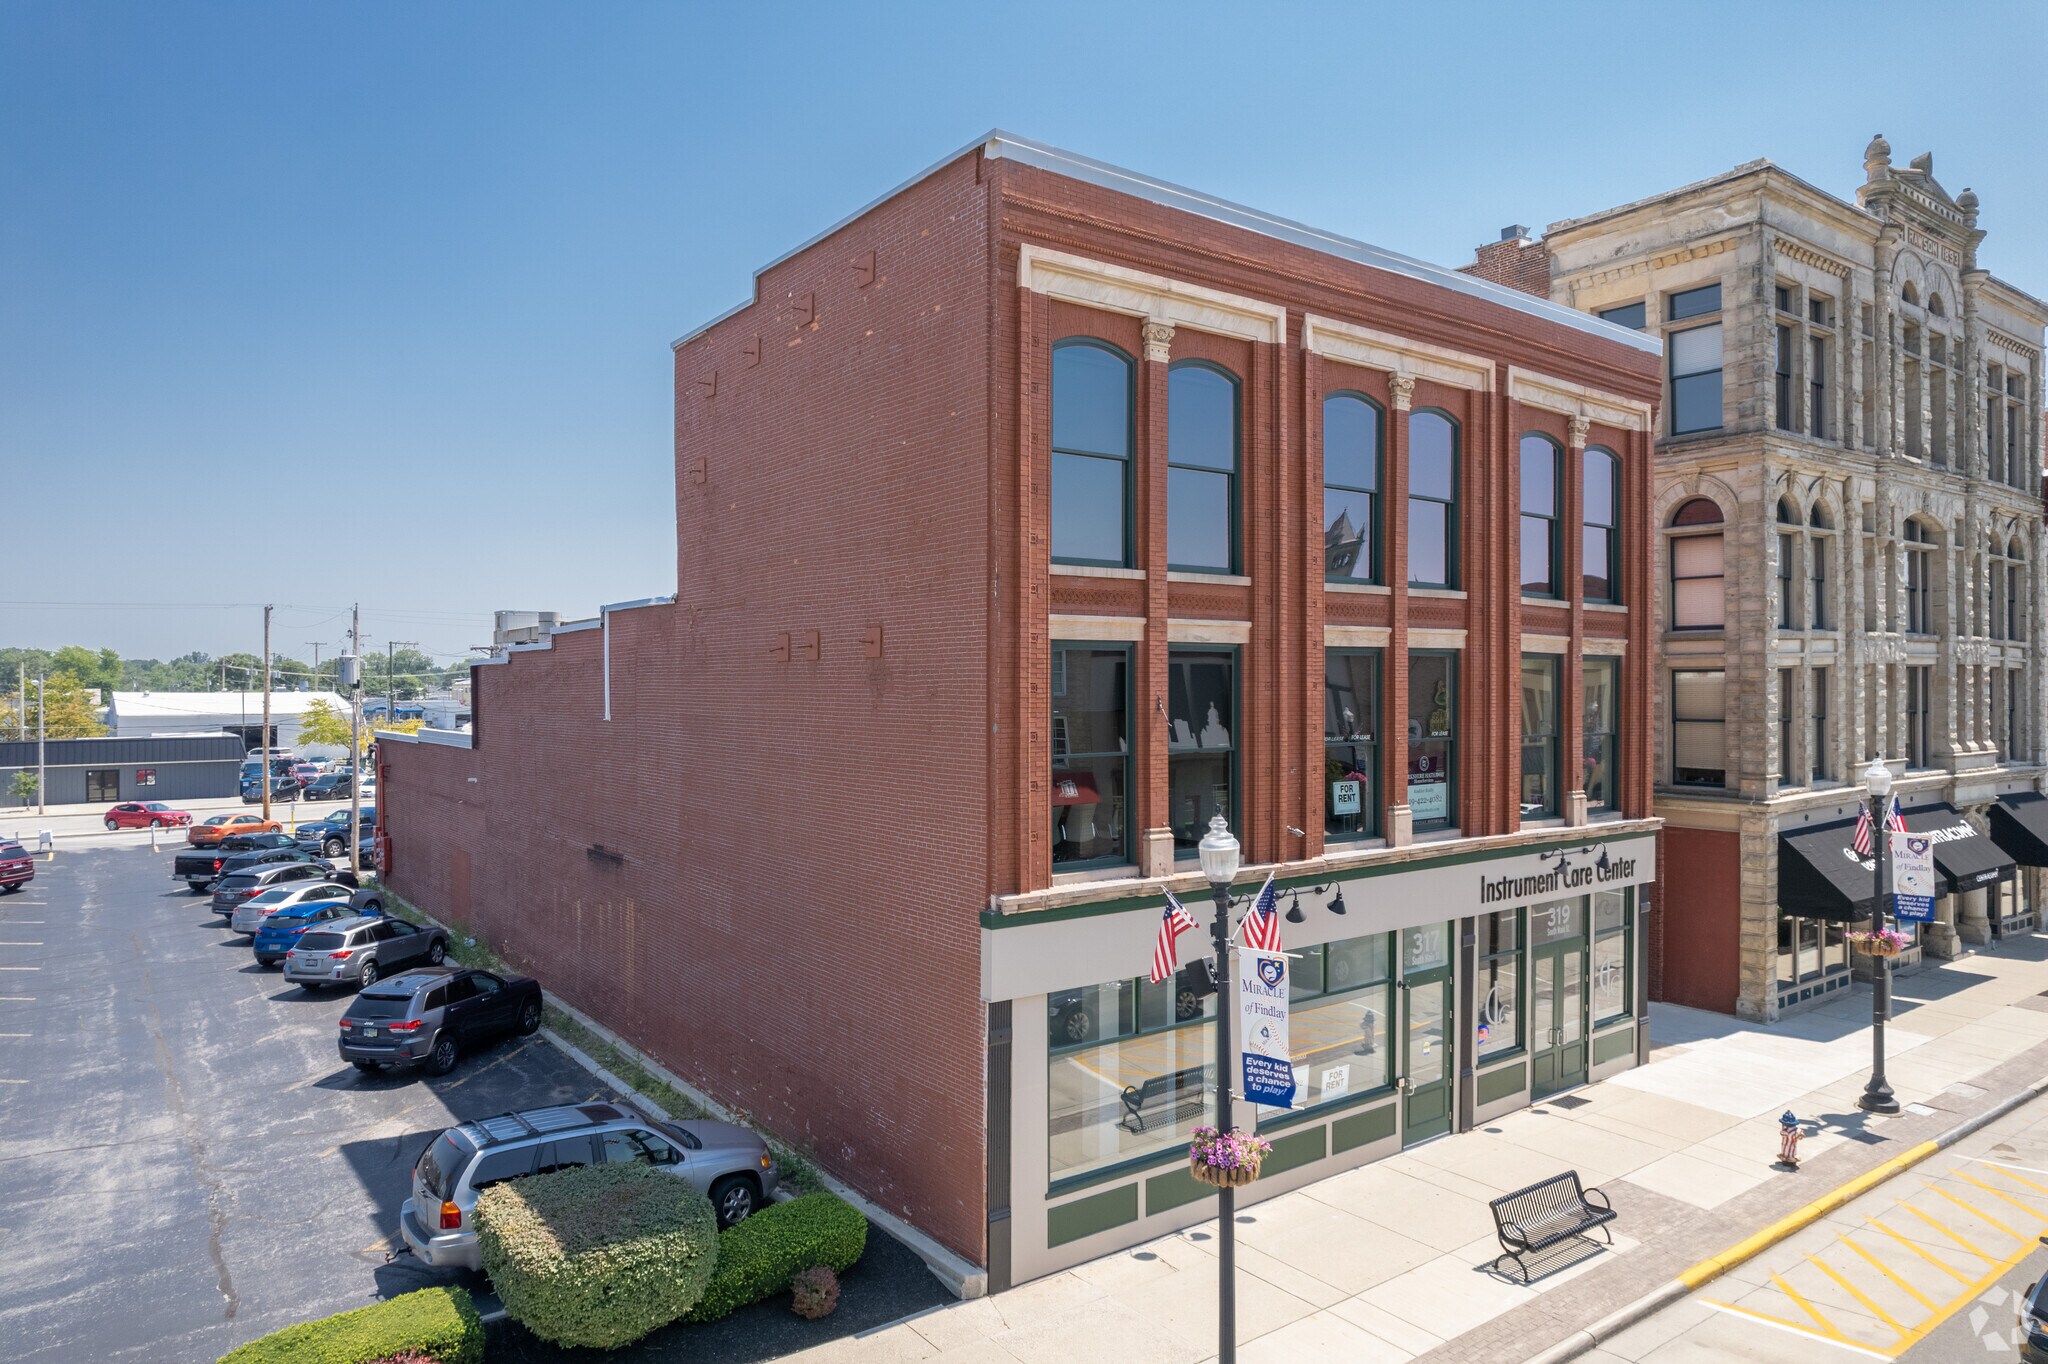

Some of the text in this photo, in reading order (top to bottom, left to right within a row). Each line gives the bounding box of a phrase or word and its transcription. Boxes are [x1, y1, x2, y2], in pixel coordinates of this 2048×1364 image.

[1942, 246, 1959, 266] 1893
[1340, 784, 1354, 793] FOR
[1338, 793, 1356, 803] RENT
[1904, 864, 1931, 874] Findlay
[1480, 857, 1636, 904] Instrument Care Center
[1547, 904, 1570, 926] 319
[1412, 930, 1440, 954] 317
[1242, 979, 1285, 999] MIRACLE
[1245, 1002, 1286, 1022] of Findlay
[1246, 1057, 1288, 1072] Every kid
[1247, 1067, 1290, 1080] deserves
[1329, 1071, 1343, 1081] FOR
[1256, 1076, 1291, 1088] chance
[1326, 1078, 1345, 1091] RENT
[1252, 1083, 1287, 1096] to play!
